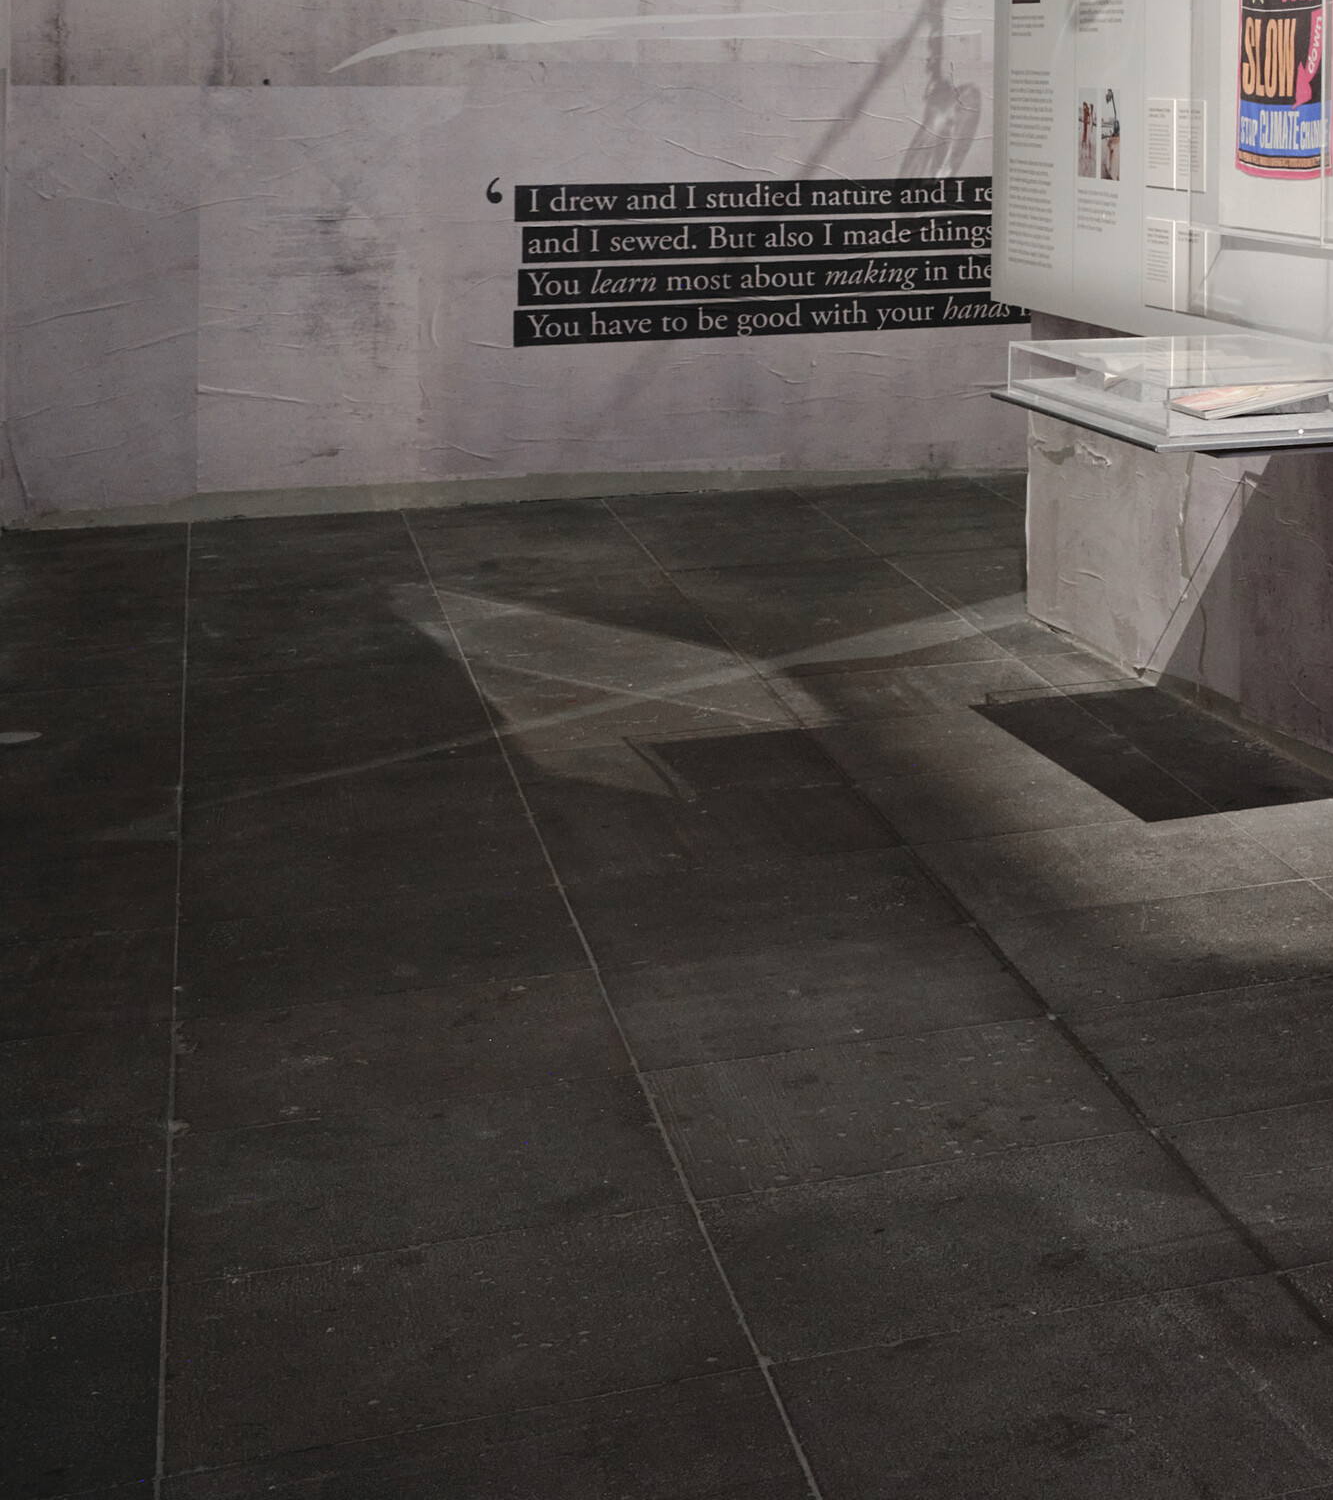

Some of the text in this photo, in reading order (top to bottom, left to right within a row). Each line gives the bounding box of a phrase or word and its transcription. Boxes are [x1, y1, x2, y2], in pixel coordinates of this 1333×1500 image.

[1243, 17, 1297, 97] SLOW
[1308, 16, 1322, 74] down
[1259, 108, 1301, 150] CLIMATE
[529, 228, 579, 254] and
[591, 229, 599, 252] I
[610, 226, 696, 251] sewed.
[709, 226, 755, 248] But
[765, 223, 813, 247] also
[824, 223, 832, 245] I
[844, 220, 911, 245] made
